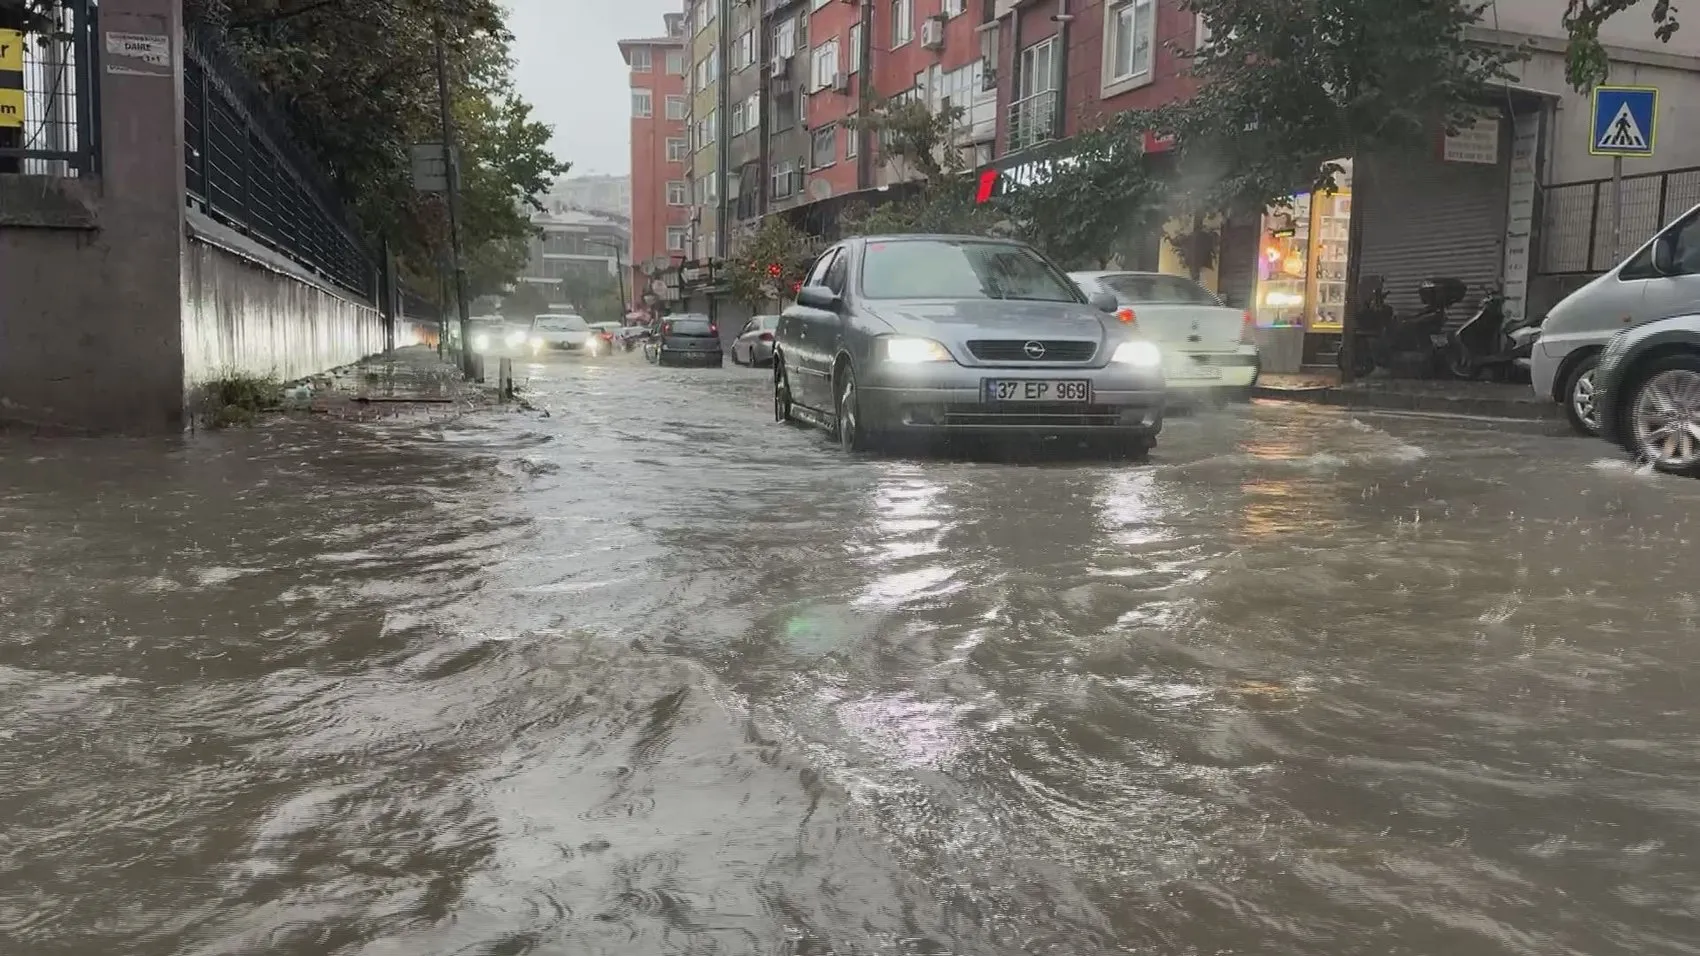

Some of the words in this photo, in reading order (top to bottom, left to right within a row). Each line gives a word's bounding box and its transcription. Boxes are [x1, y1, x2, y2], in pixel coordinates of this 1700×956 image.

[998, 382, 1018, 399] 37
[1025, 382, 1048, 399] EP
[1057, 382, 1086, 399] 969
